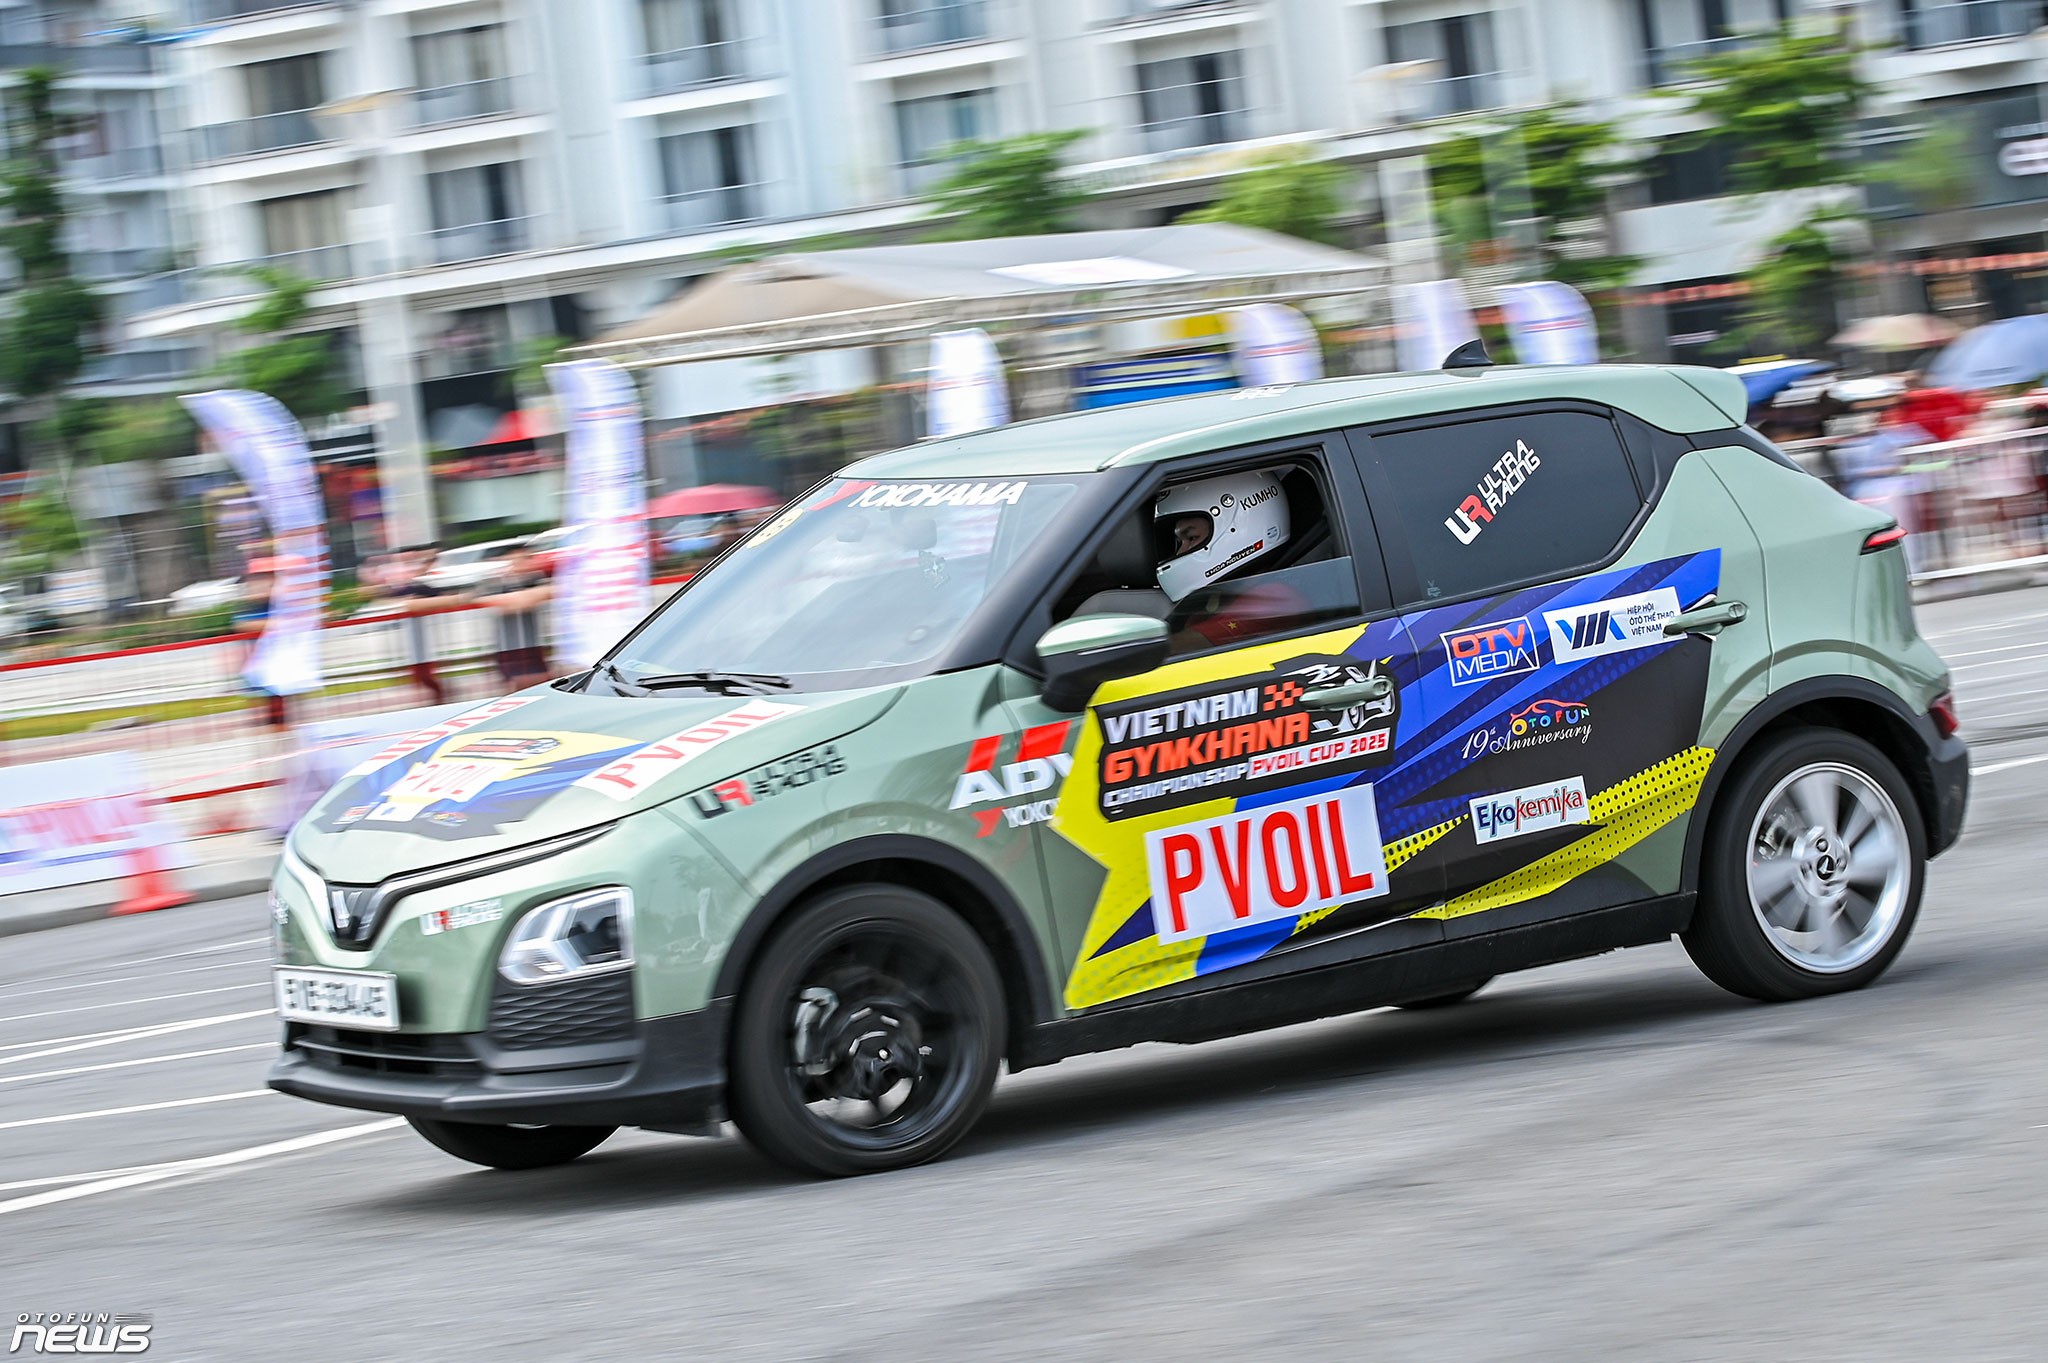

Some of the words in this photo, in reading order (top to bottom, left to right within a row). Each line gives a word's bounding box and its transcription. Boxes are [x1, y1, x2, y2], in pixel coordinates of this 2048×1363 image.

[1477, 438, 1529, 498] ULTRA
[1486, 448, 1541, 515] RACING
[848, 481, 1029, 508] YOKOHAMA
[1239, 485, 1279, 511] KUMHO
[1444, 494, 1494, 545] UR
[1451, 624, 1525, 658] OTV
[1646, 623, 1663, 634] NAM
[1456, 647, 1534, 678] MEDIA
[1104, 688, 1258, 744] VIETNAM
[1489, 724, 1592, 754] Anniversary
[1512, 708, 1590, 736] OTOFUN
[593, 710, 786, 789] PVOIL
[1103, 763, 1250, 808] CHAMPIONSHIP
[1252, 752, 1304, 775] PVOIL
[1309, 742, 1345, 763] CUP
[1350, 732, 1388, 755] 2025
[1104, 712, 1311, 784] GYMKHANA
[1475, 787, 1584, 837] Ekokemika
[1160, 799, 1374, 933] PVOIL
